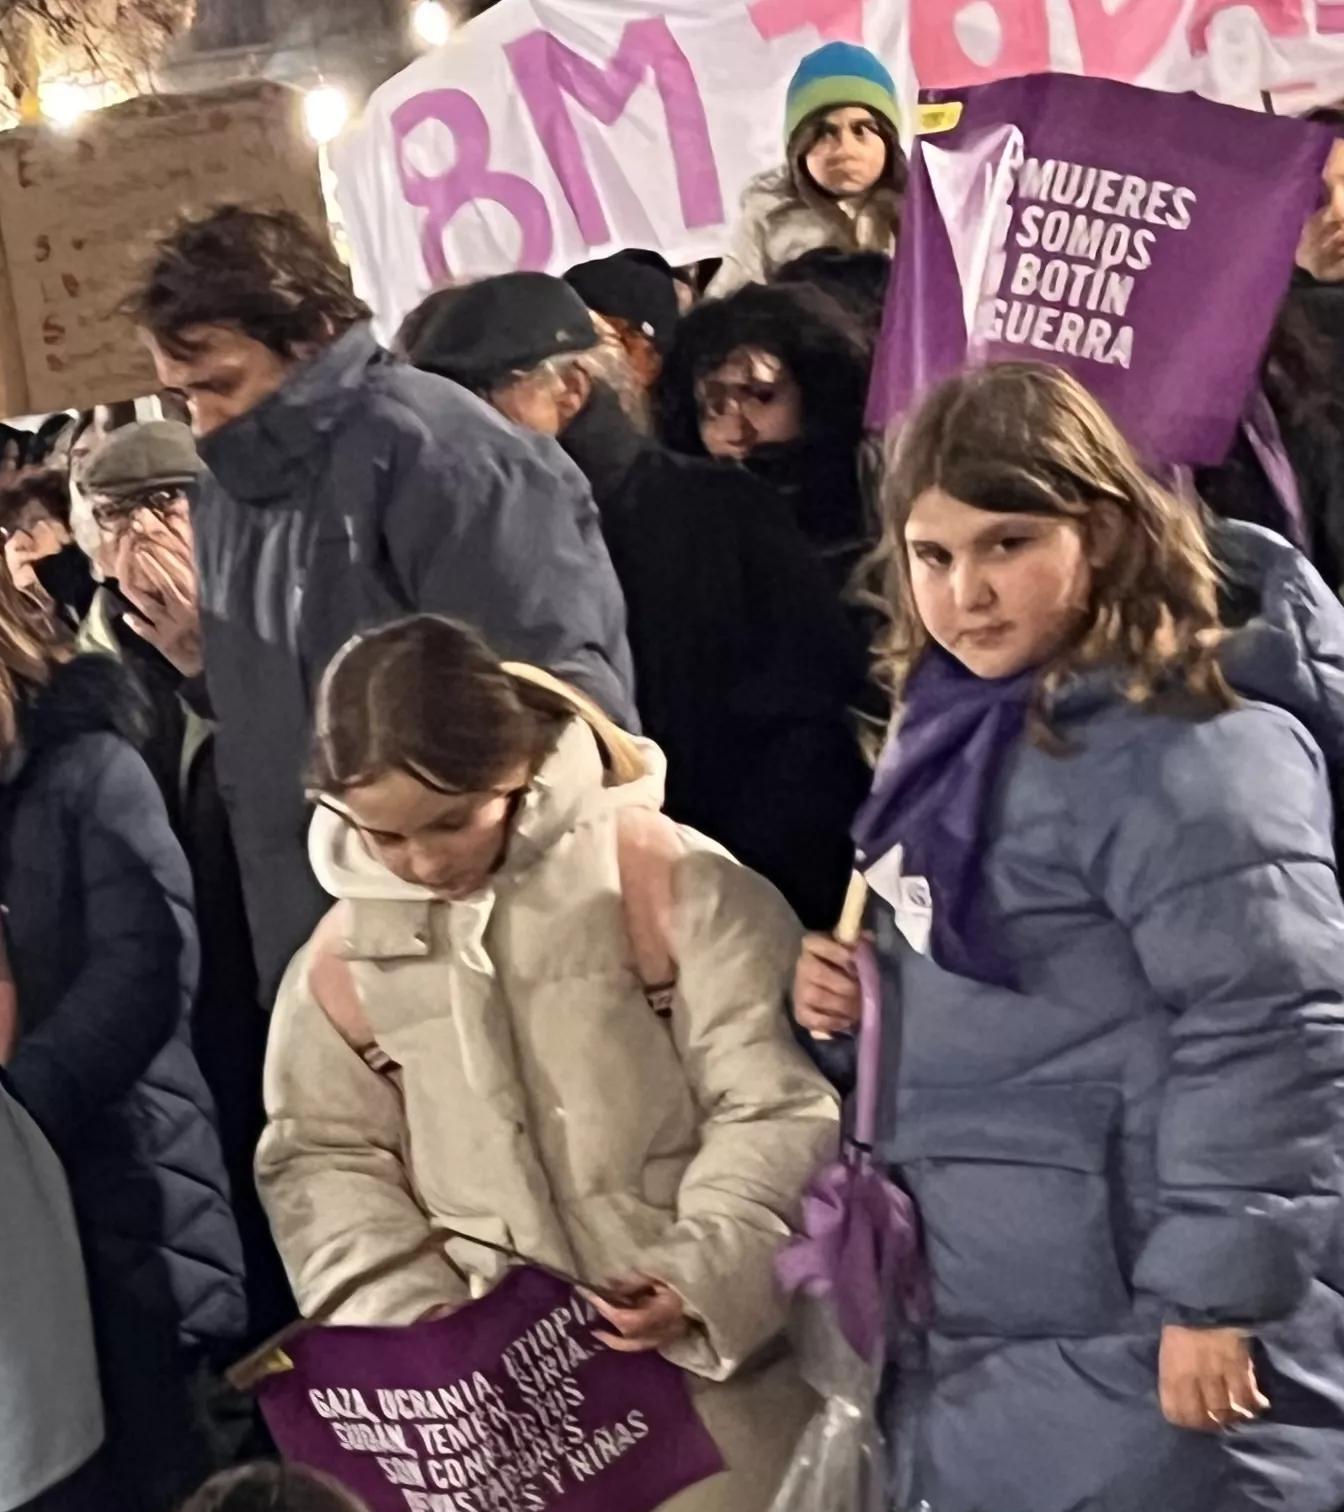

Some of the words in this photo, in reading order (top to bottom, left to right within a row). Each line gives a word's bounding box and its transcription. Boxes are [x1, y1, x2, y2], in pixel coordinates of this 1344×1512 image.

[390, 17, 726, 284] 8M
[1018, 157, 1197, 230] MUJERES
[1015, 205, 1157, 271] SOMOS
[565, 1408, 650, 1483] NIÑAS
